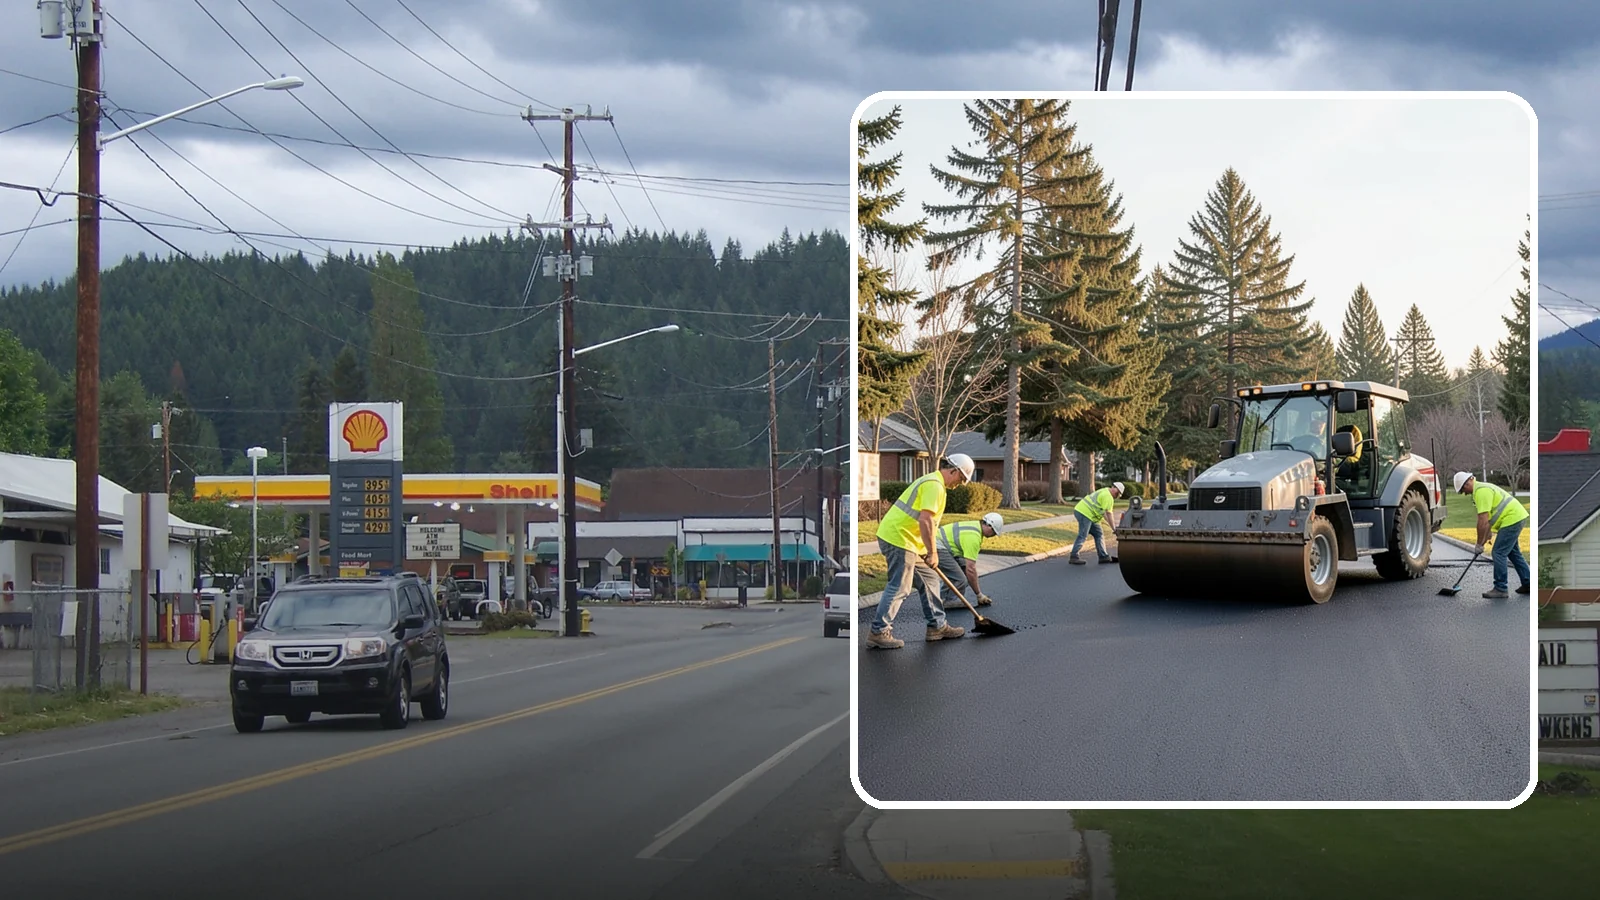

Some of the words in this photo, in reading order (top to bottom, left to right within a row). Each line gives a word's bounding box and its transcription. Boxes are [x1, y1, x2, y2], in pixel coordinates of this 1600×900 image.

[365, 480, 383, 490] 395
[490, 484, 547, 499] Shell
[365, 494, 383, 504] 405
[365, 508, 383, 518] 415
[365, 522, 383, 533] 429
[1539, 643, 1567, 665] AID
